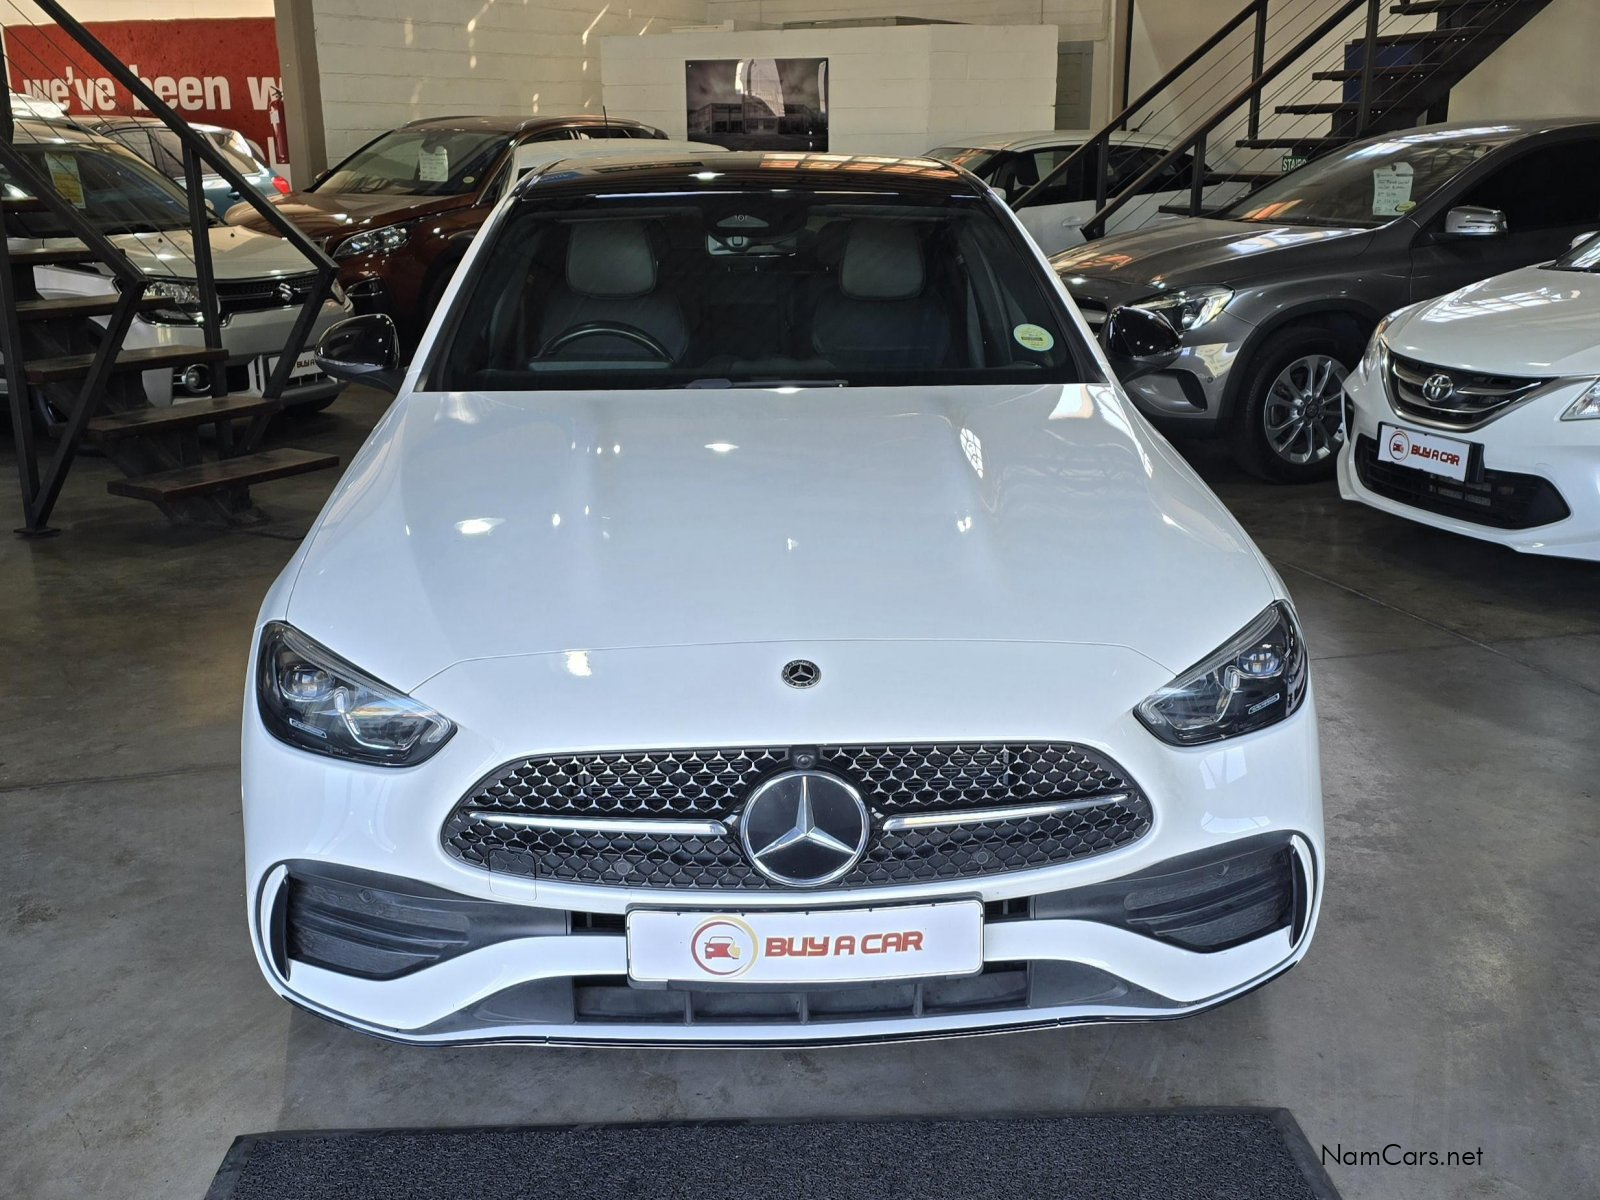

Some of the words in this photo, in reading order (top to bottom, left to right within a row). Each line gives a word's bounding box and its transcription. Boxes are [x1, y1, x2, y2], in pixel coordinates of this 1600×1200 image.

[23, 66, 116, 111] we've
[129, 64, 231, 111] been
[1411, 444, 1432, 459] BUY
[1431, 450, 1439, 460] A
[1440, 451, 1460, 466] CAR
[765, 936, 830, 958] BUY
[834, 935, 855, 956] A
[861, 931, 924, 954] CAR
